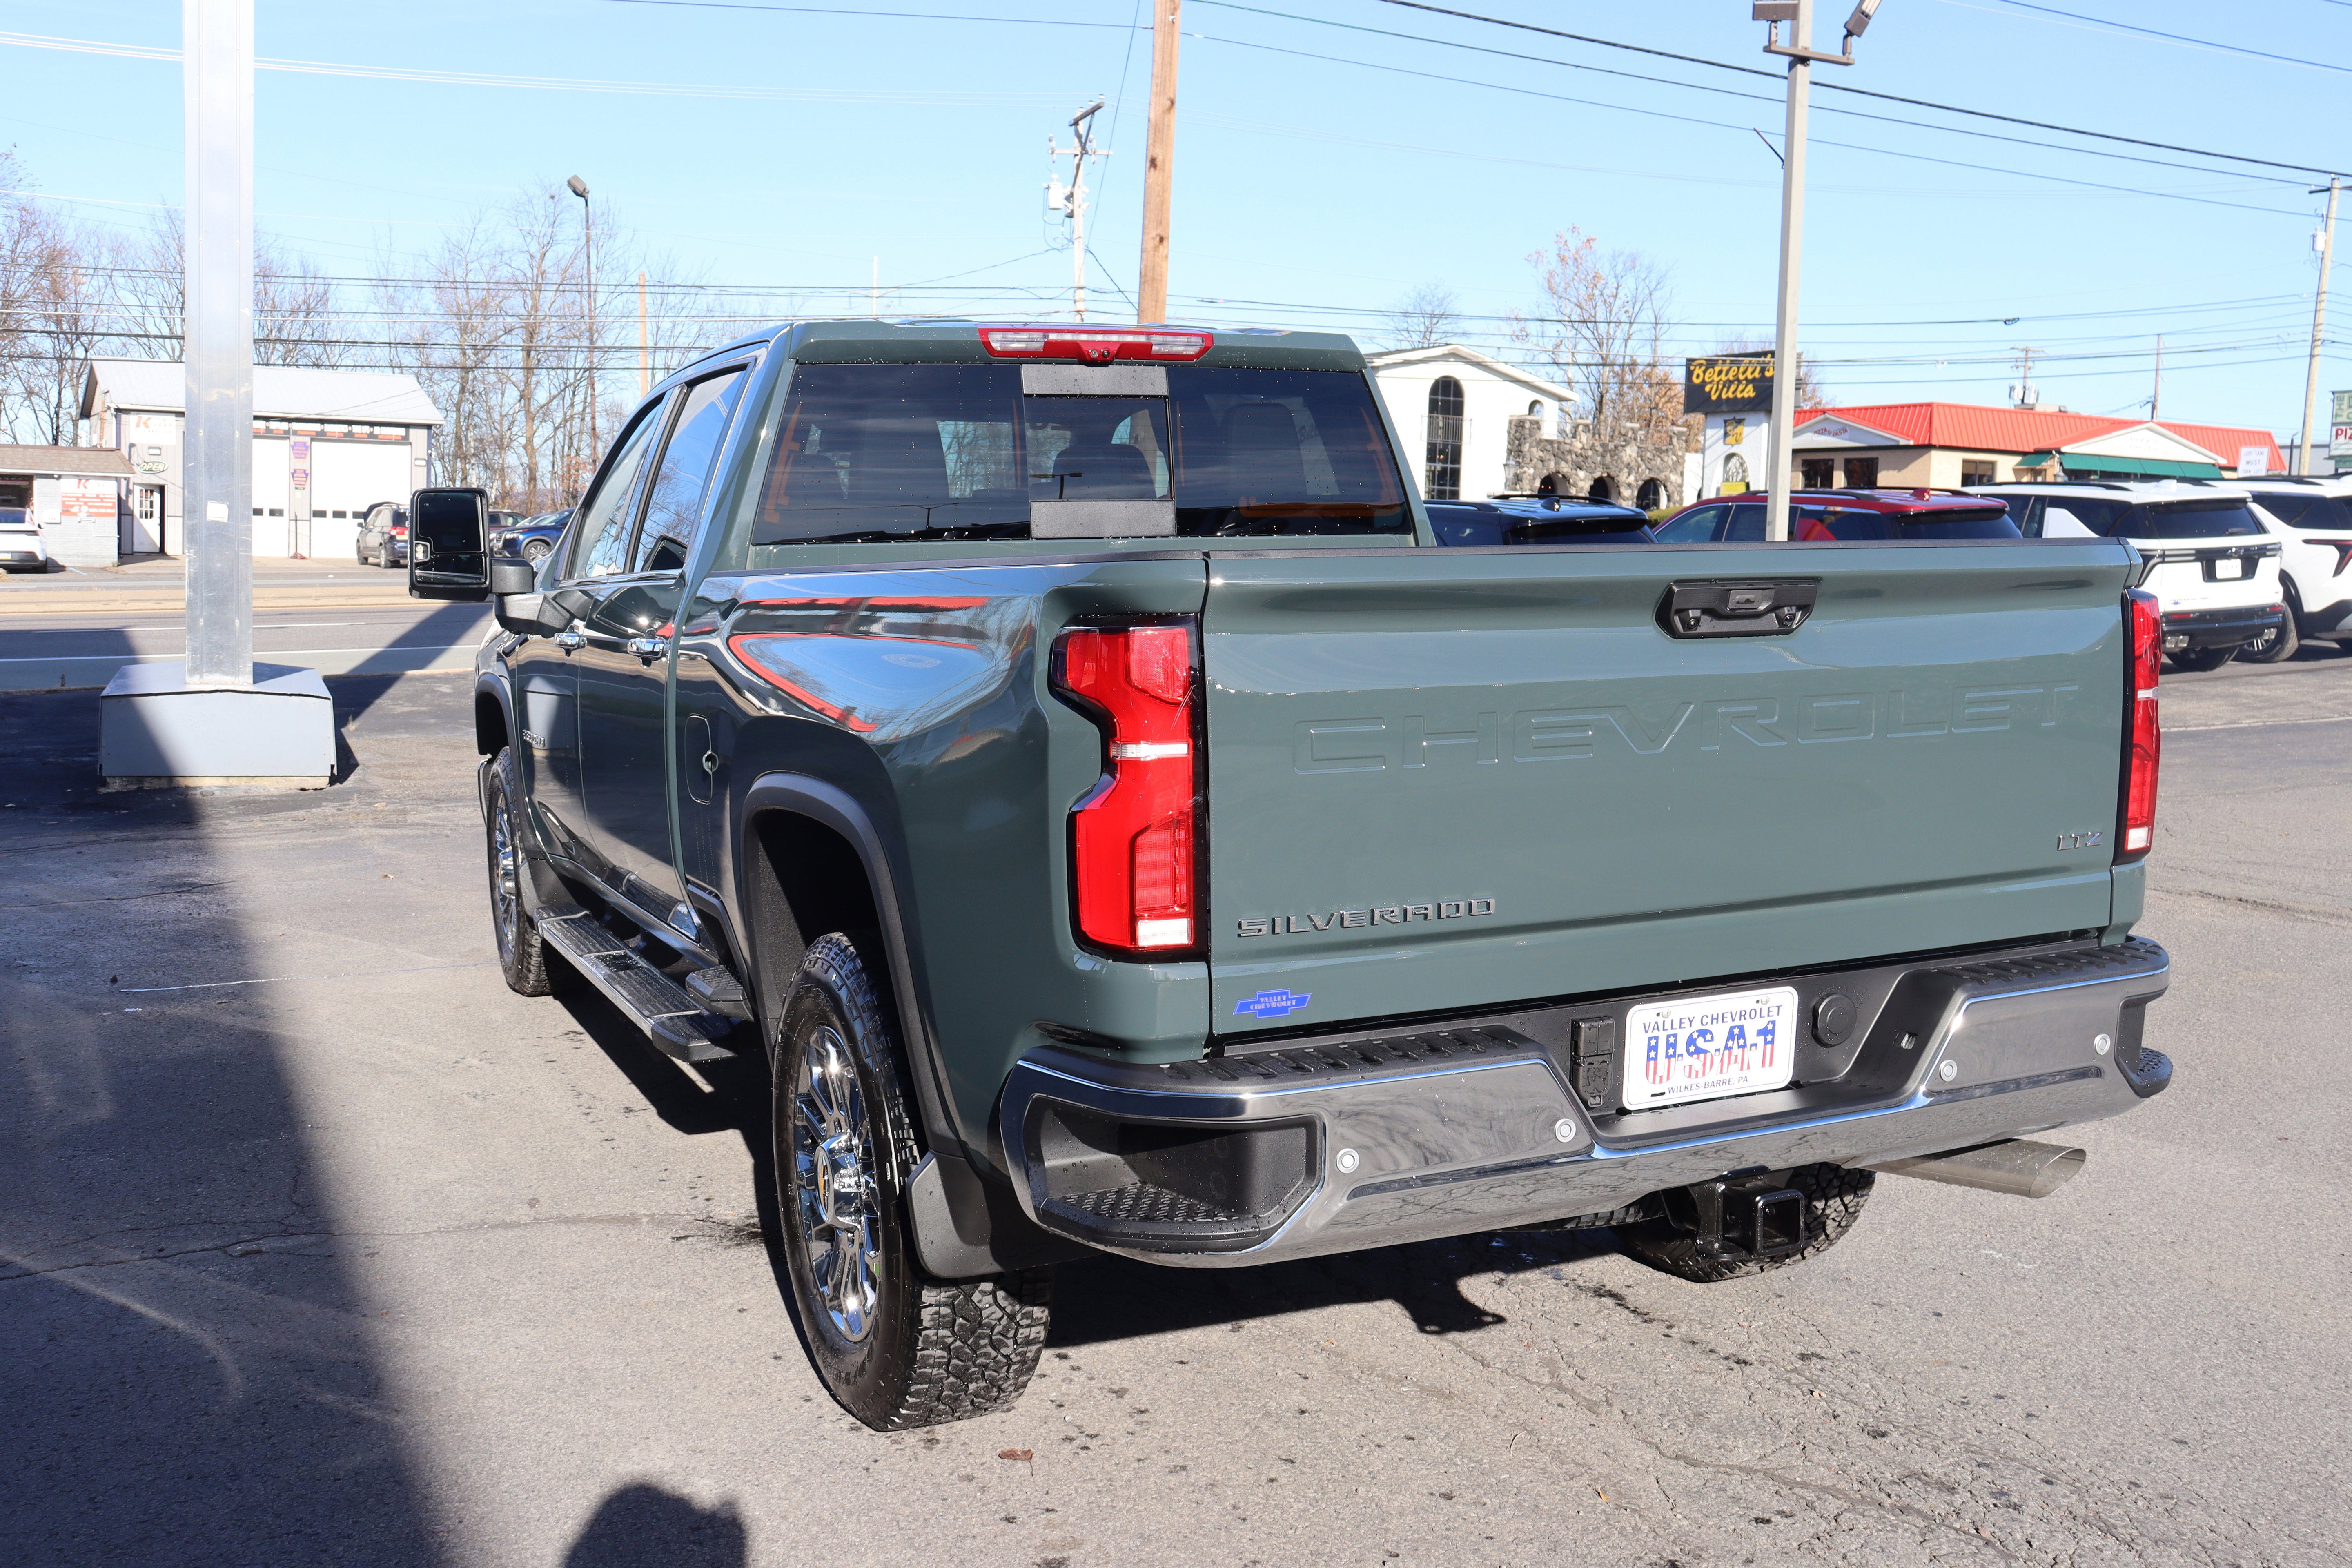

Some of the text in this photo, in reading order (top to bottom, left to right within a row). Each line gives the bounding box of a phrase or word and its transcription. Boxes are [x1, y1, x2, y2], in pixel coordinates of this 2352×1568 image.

[1690, 354, 1775, 384] Bettelli's
[1705, 380, 1756, 401] Villa
[1813, 427, 1827, 436] PIZZA
[1832, 428, 1848, 437] PASTA
[140, 462, 165, 471] OPEN
[1294, 685, 2079, 775] CHEVROLET
[2057, 831, 2103, 851] LTZ
[1237, 898, 1495, 937] SILVERADO
[1250, 1000, 1296, 1010] CHEVROLET
[1643, 1005, 1782, 1034] VALLEY CHEVROLET
[1668, 1077, 1735, 1094] WILKES-BARRE,
